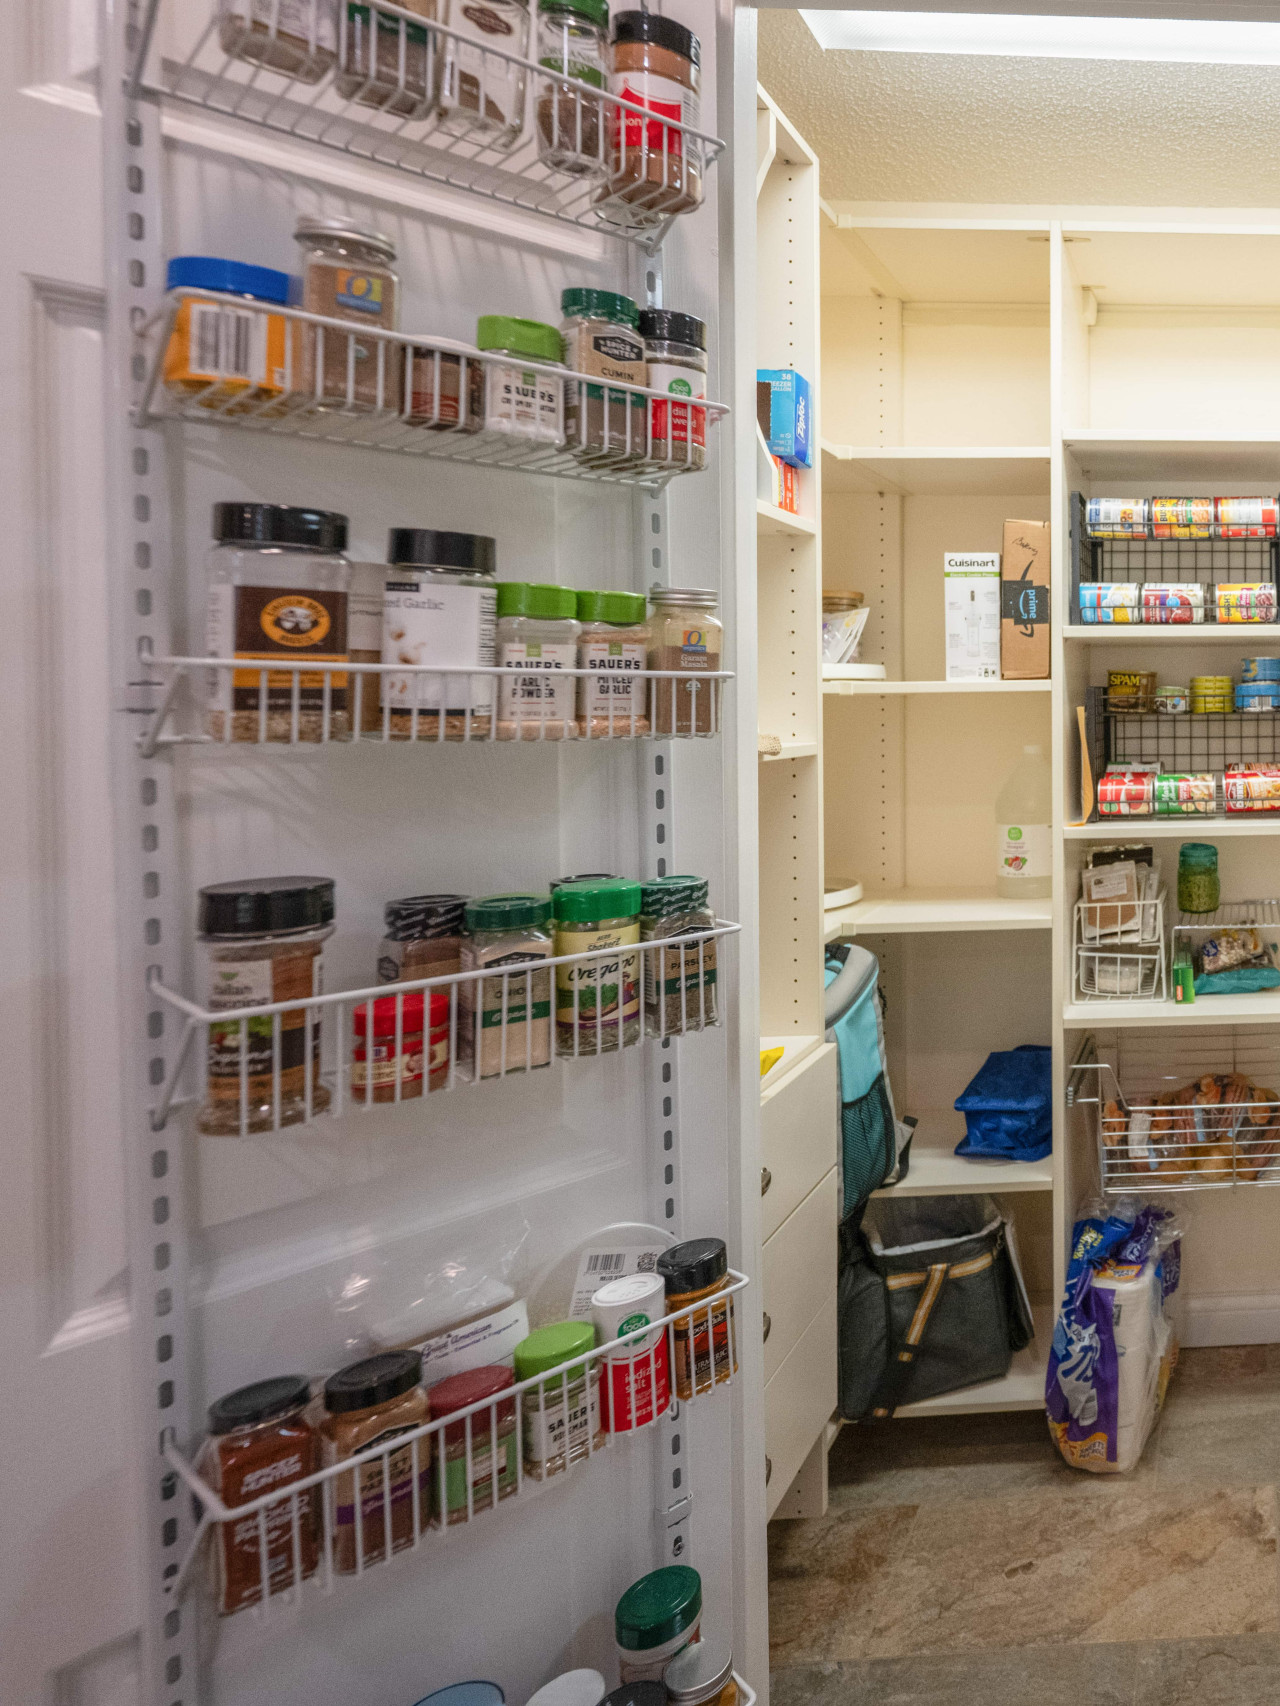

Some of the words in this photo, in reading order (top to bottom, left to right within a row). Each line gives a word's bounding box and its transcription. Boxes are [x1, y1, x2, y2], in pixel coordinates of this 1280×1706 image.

[601, 367, 634, 381] CUMIN
[797, 396, 805, 439] Ziploc
[672, 418, 697, 429] wed
[948, 558, 995, 567] Cuisinart
[1026, 589, 1038, 619] prime
[681, 654, 707, 662] Garam
[589, 659, 641, 670] SAUER'S
[680, 660, 708, 668] Masala
[1109, 675, 1140, 686] SPAM
[567, 954, 635, 982] Oregano
[625, 1379, 647, 1394] slt
